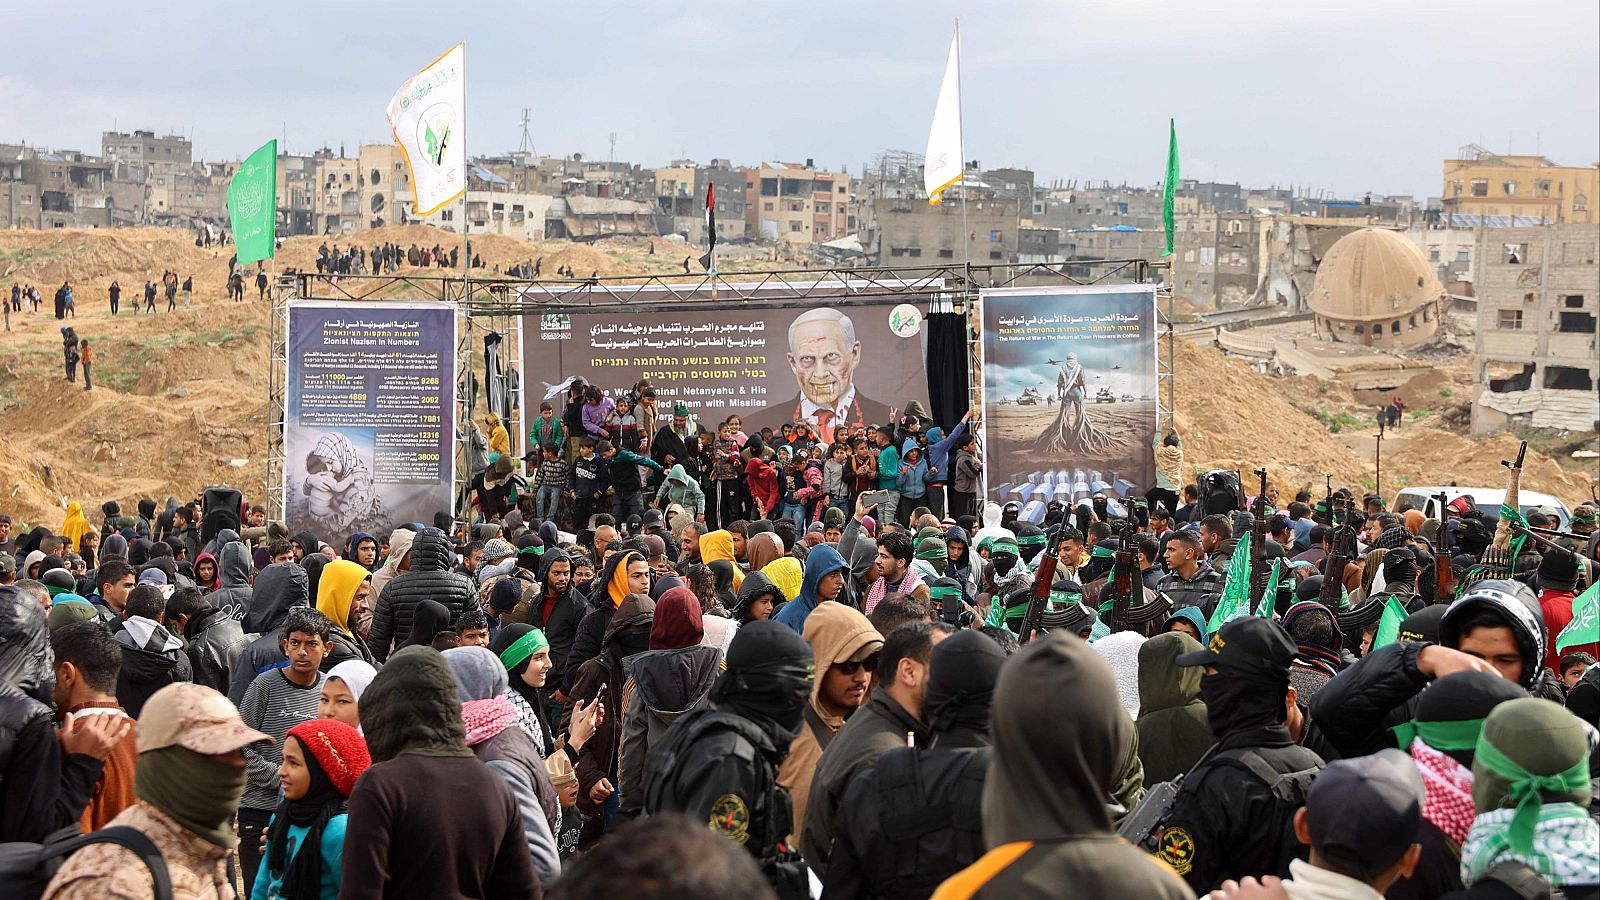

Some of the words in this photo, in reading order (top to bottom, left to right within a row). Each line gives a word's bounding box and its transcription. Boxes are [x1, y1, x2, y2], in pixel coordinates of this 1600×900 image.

[590, 323, 618, 336] النازي
[648, 322, 682, 335] نتنياهو
[683, 322, 714, 335] الحرب
[715, 324, 738, 334] مجرم
[739, 321, 765, 334] قتلهم
[590, 337, 643, 350] الصهيونية
[643, 336, 682, 350] الحربية
[683, 336, 726, 349] الطائرات
[727, 335, 766, 348] بصواريخ
[633, 355, 679, 366] המלחמה
[714, 356, 741, 365] אותם
[745, 356, 766, 364] רצח
[683, 386, 734, 396] Netanyahu
[738, 386, 746, 394] &
[751, 386, 767, 394] His
[676, 400, 702, 408] Them
[706, 399, 725, 408] with
[729, 398, 767, 407] Missiles
[418, 453, 440, 461] 38000
